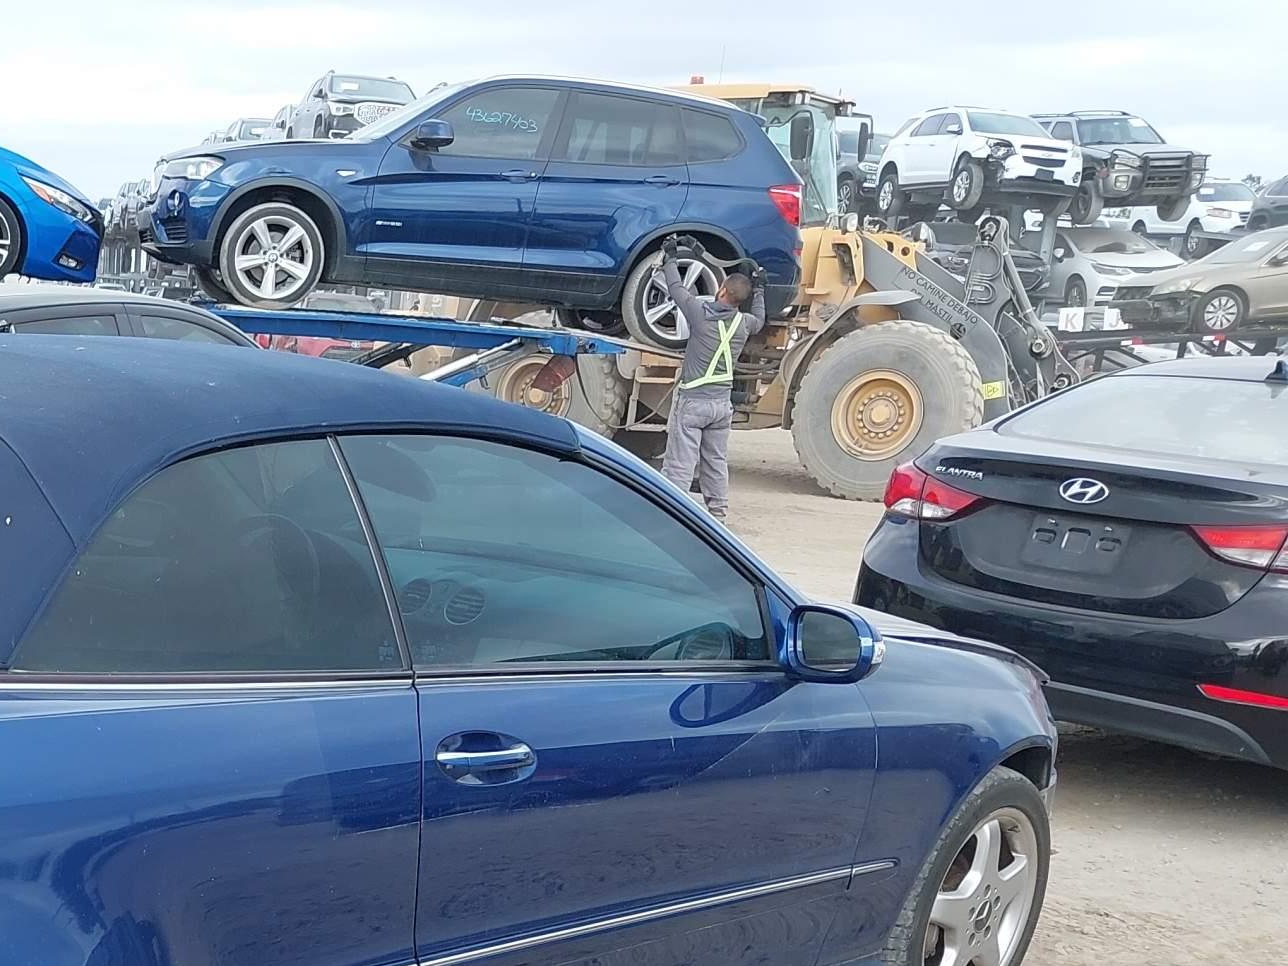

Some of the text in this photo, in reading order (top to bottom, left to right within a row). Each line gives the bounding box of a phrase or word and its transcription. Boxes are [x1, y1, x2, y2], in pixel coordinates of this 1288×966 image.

[466, 106, 538, 132] 43627403
[902, 267, 916, 280] NO
[916, 278, 949, 303] CAMINE
[946, 300, 978, 324] DEBAJO
[1064, 312, 1078, 330] K
[935, 466, 984, 481] ELANTRA
